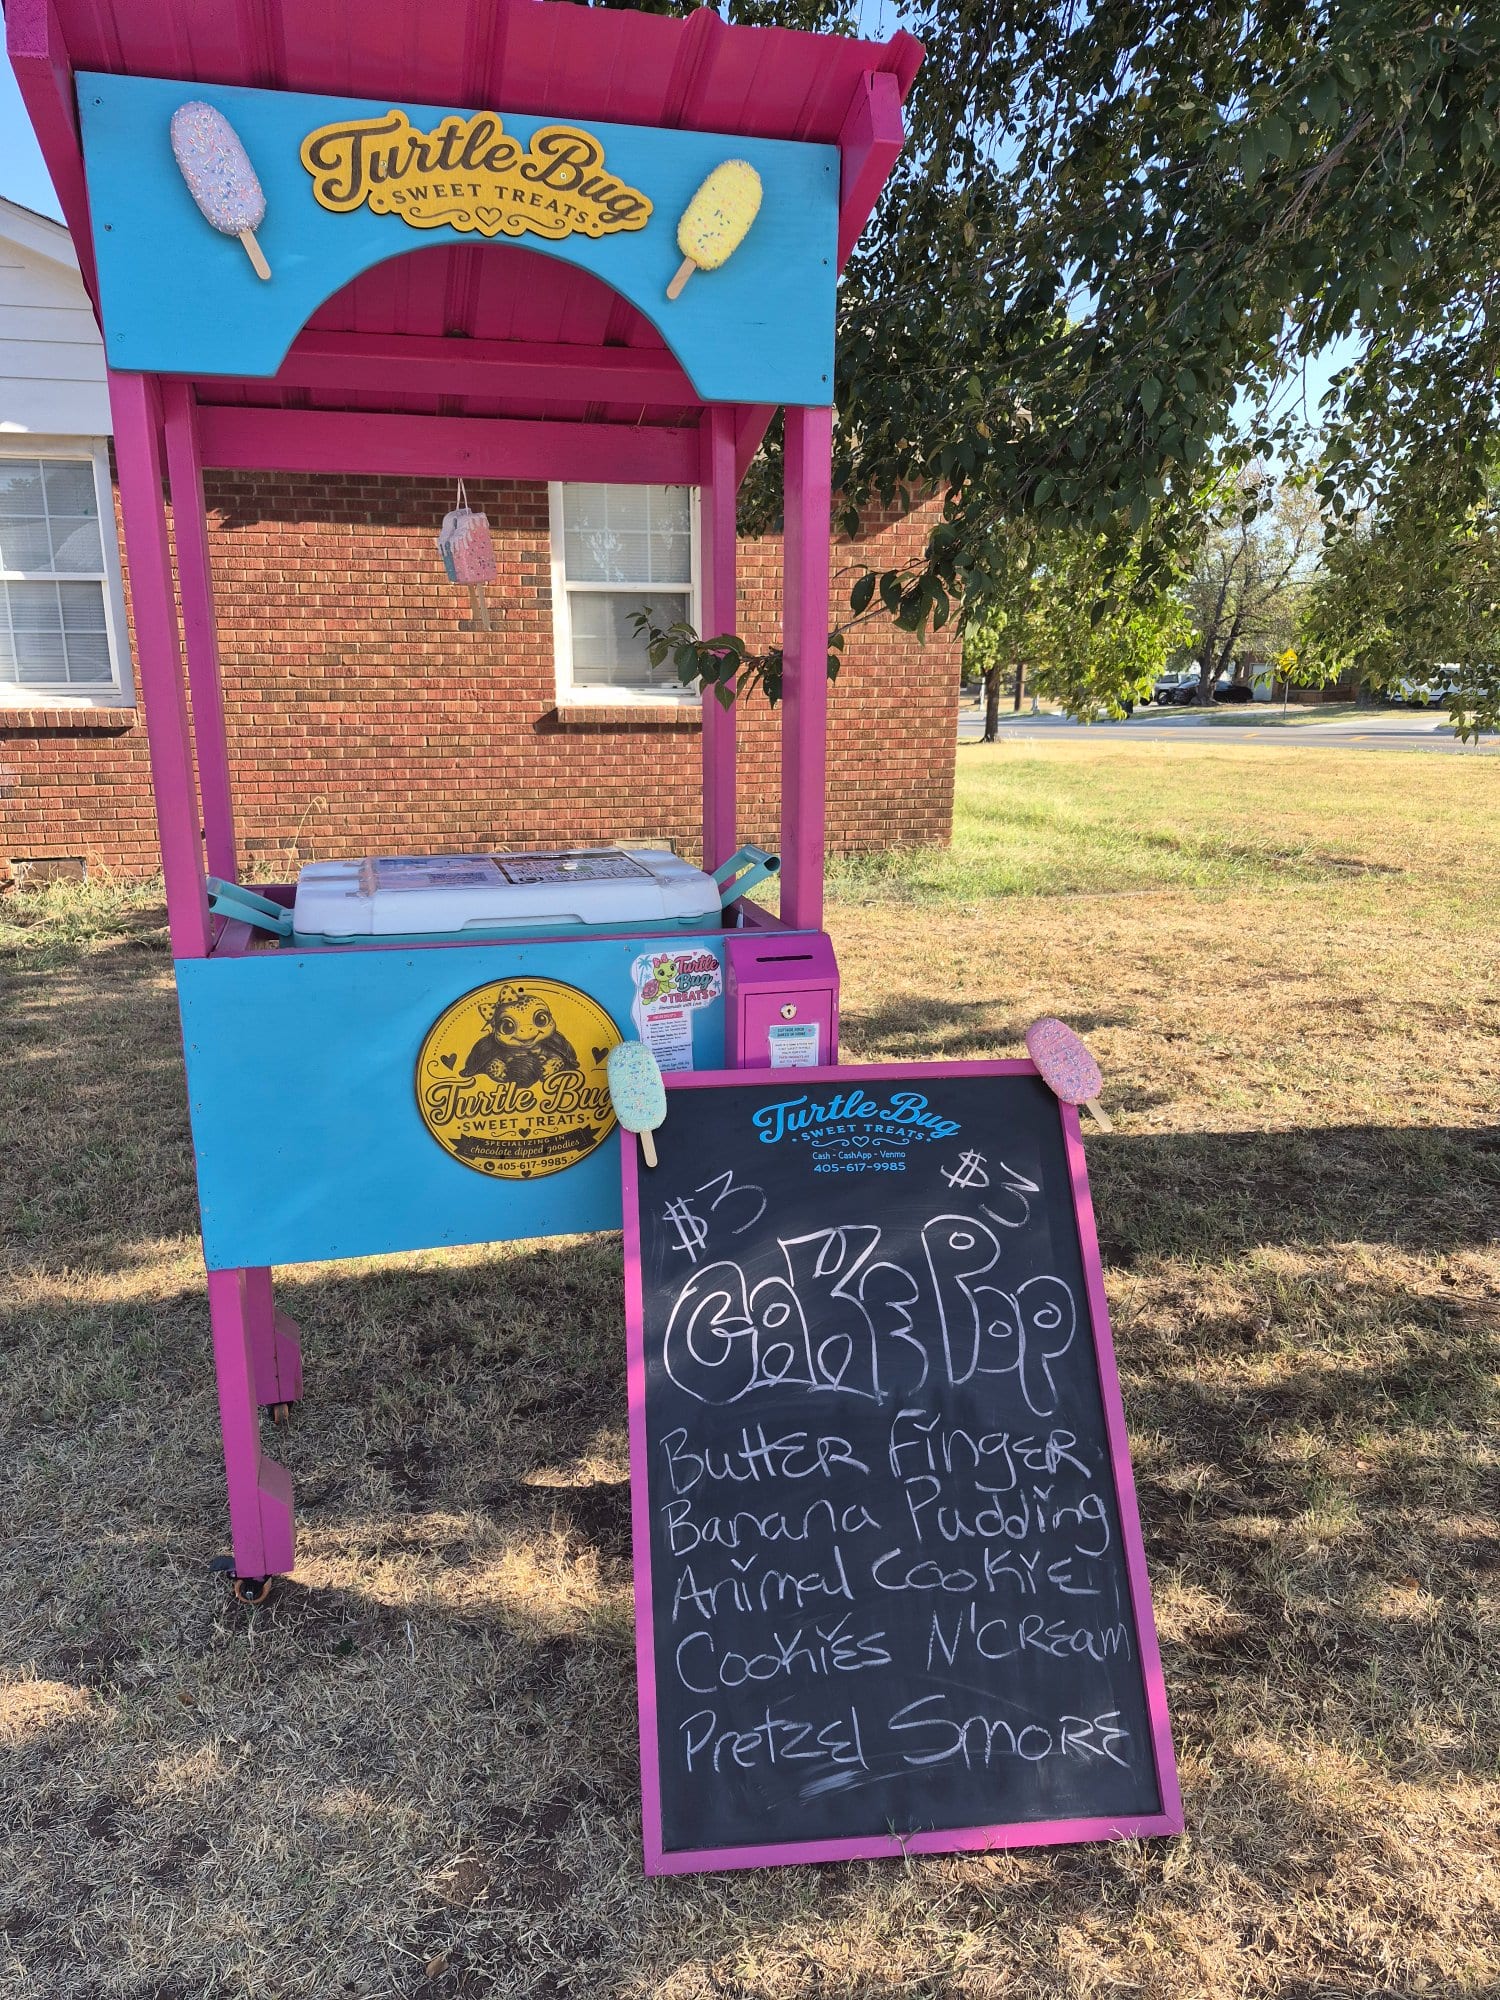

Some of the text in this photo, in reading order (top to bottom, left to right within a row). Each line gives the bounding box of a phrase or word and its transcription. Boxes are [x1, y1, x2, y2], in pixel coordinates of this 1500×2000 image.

[308, 117, 647, 225] Turtle Bug
[392, 183, 587, 223] SWEET TREATS
[674, 953, 720, 975] Turtle
[674, 971, 714, 993] Bug
[667, 990, 709, 1004] TREATS
[425, 1069, 614, 1127] Turtle Bug
[462, 1113, 586, 1132] SWEET TREATS
[752, 1090, 962, 1144] Turtle Bug
[484, 1137, 550, 1147] SPECIALIZING
[801, 1123, 925, 1141] SWEET TREATS
[470, 1139, 580, 1158] chocolate dipped goodies
[812, 1151, 831, 1160] Cash
[838, 1151, 873, 1160] CashApp
[879, 1150, 906, 1159] Venmo
[497, 1157, 568, 1170] 405-617-9985
[813, 1161, 906, 1173] 405-617-9985
[662, 1169, 768, 1264] $3
[660, 1474, 1111, 1556] Banana Pudding
[672, 1545, 856, 1624] Animal
